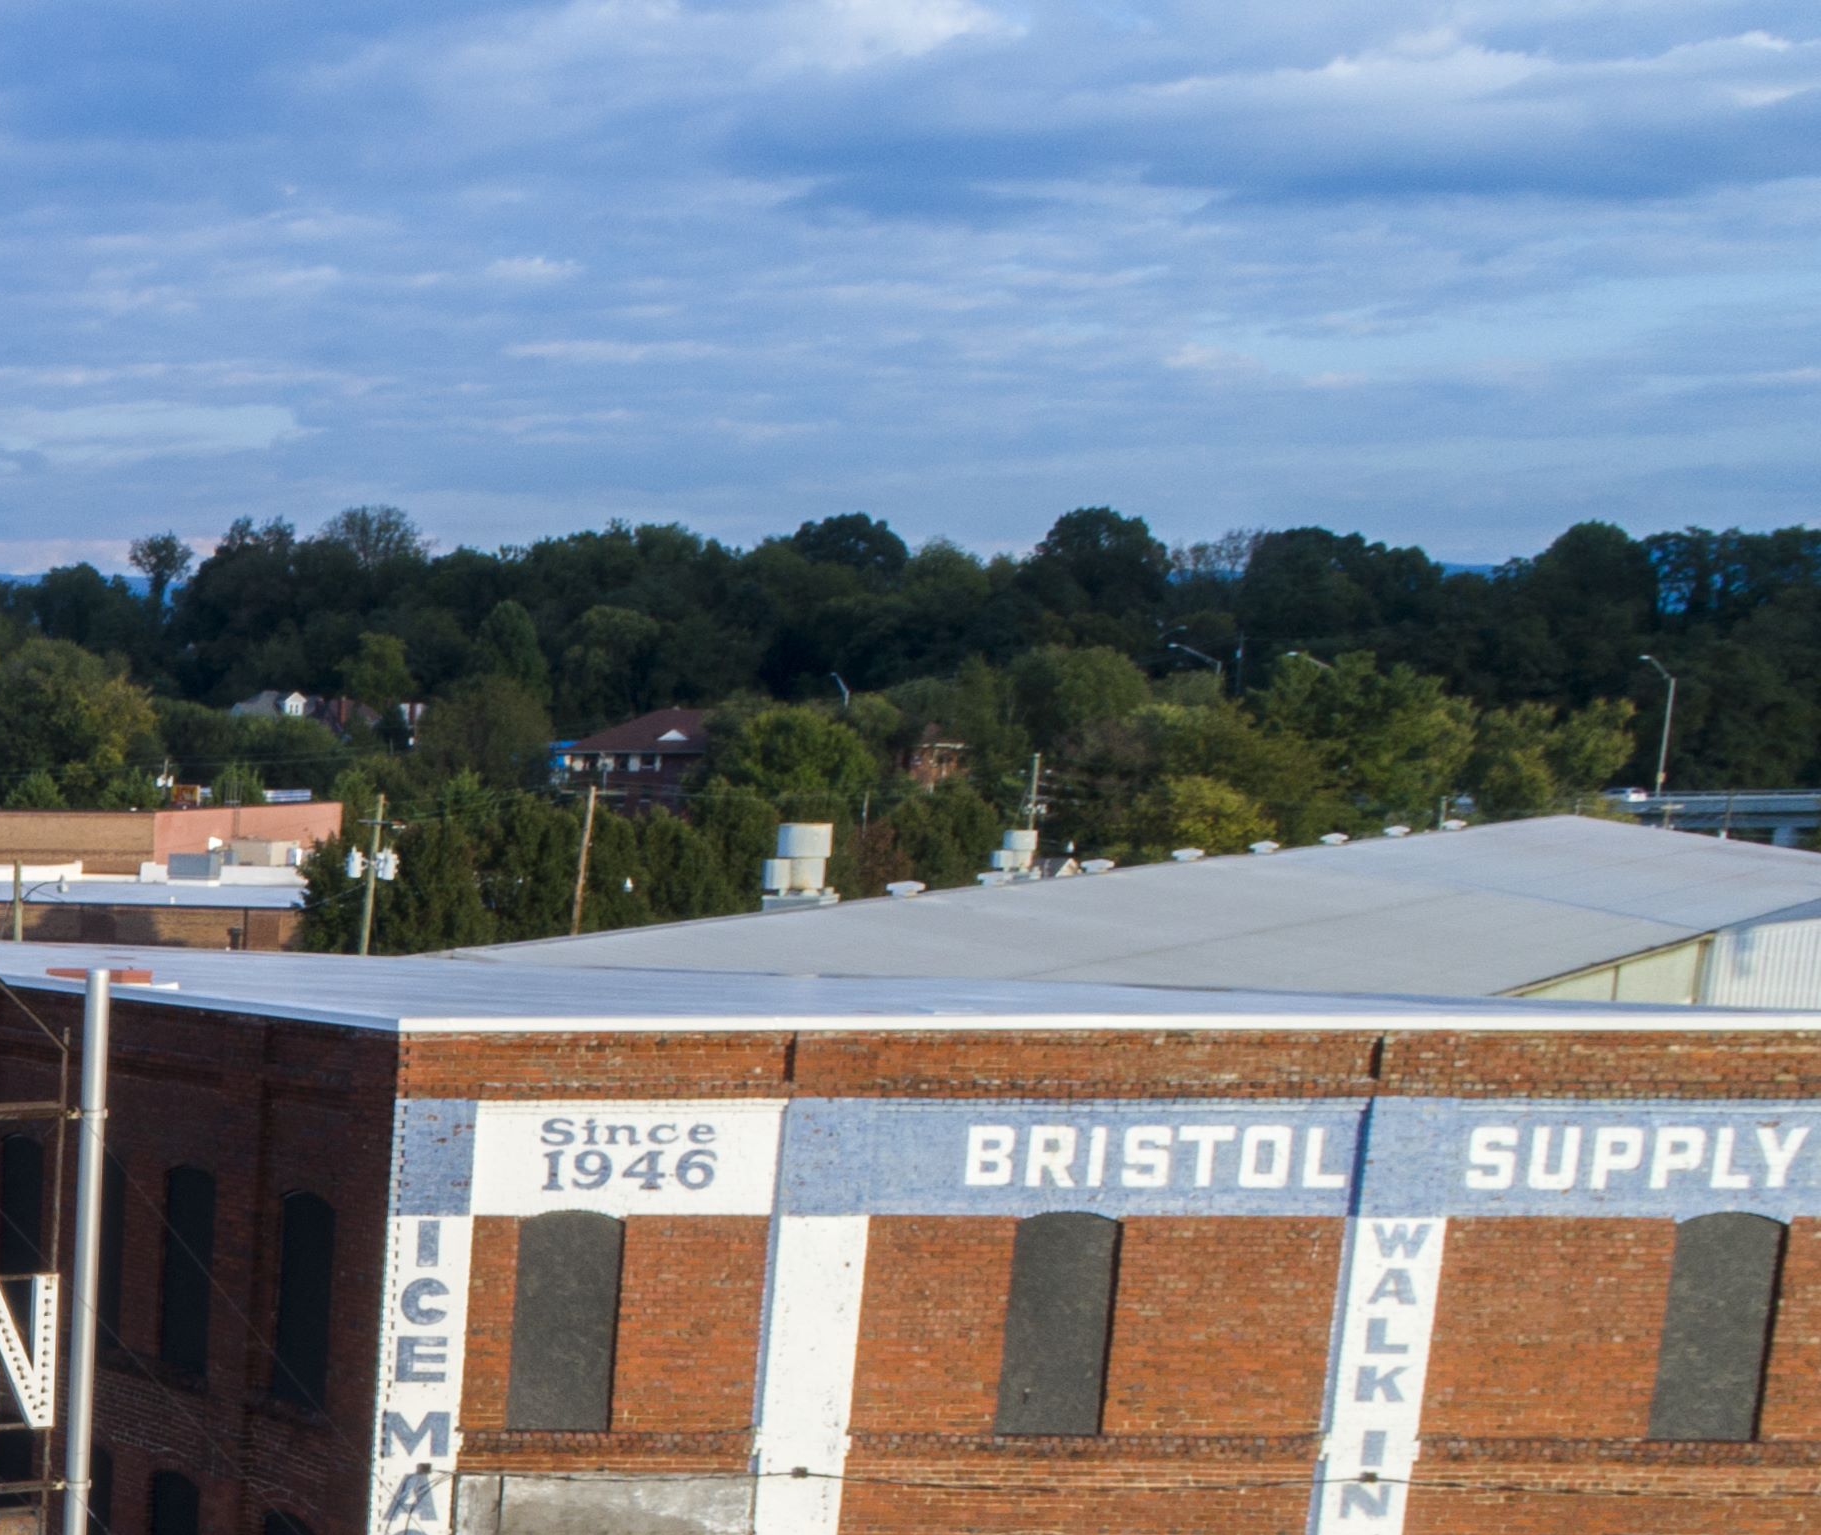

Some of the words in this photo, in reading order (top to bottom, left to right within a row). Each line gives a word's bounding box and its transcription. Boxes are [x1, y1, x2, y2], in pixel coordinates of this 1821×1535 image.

[540, 1117, 718, 1147] Since
[541, 1149, 718, 1191] 1946
[964, 1125, 1348, 1188] BRISTOL
[1466, 1126, 1811, 1190] SUPPLY
[394, 1219, 449, 1383] ICE
[1357, 1223, 1433, 1404] WALK
[1338, 1430, 1395, 1520] IN
